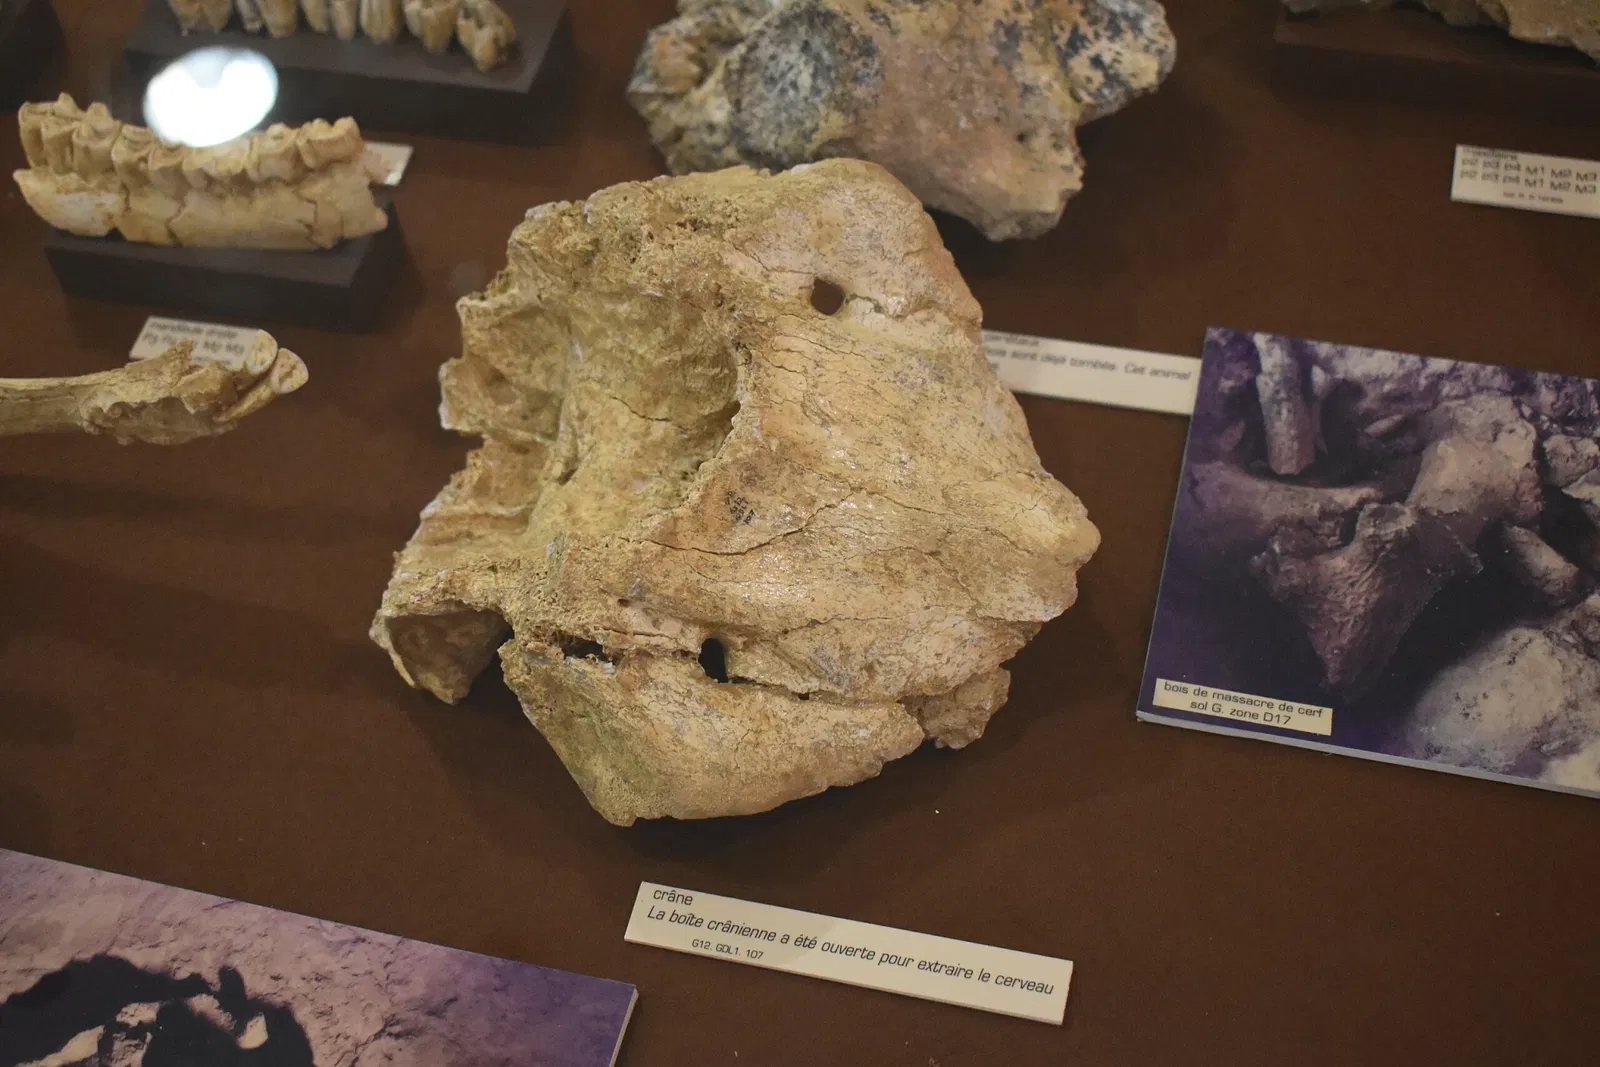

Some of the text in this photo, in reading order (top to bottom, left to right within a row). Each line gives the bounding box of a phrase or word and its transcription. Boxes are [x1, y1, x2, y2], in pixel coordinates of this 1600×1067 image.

[1124, 362, 1147, 377] Cet
[1163, 681, 1323, 718] bois de massacre de cerf
[1190, 699, 1208, 712] sol
[1229, 708, 1259, 721] zone
[1263, 711, 1292, 726] D17
[652, 888, 693, 906] crâne
[647, 905, 1055, 995] La boîte crânienne a été ouverte pour extraire le cerveau
[691, 938, 713, 951] G12.
[745, 948, 764, 960] 107
